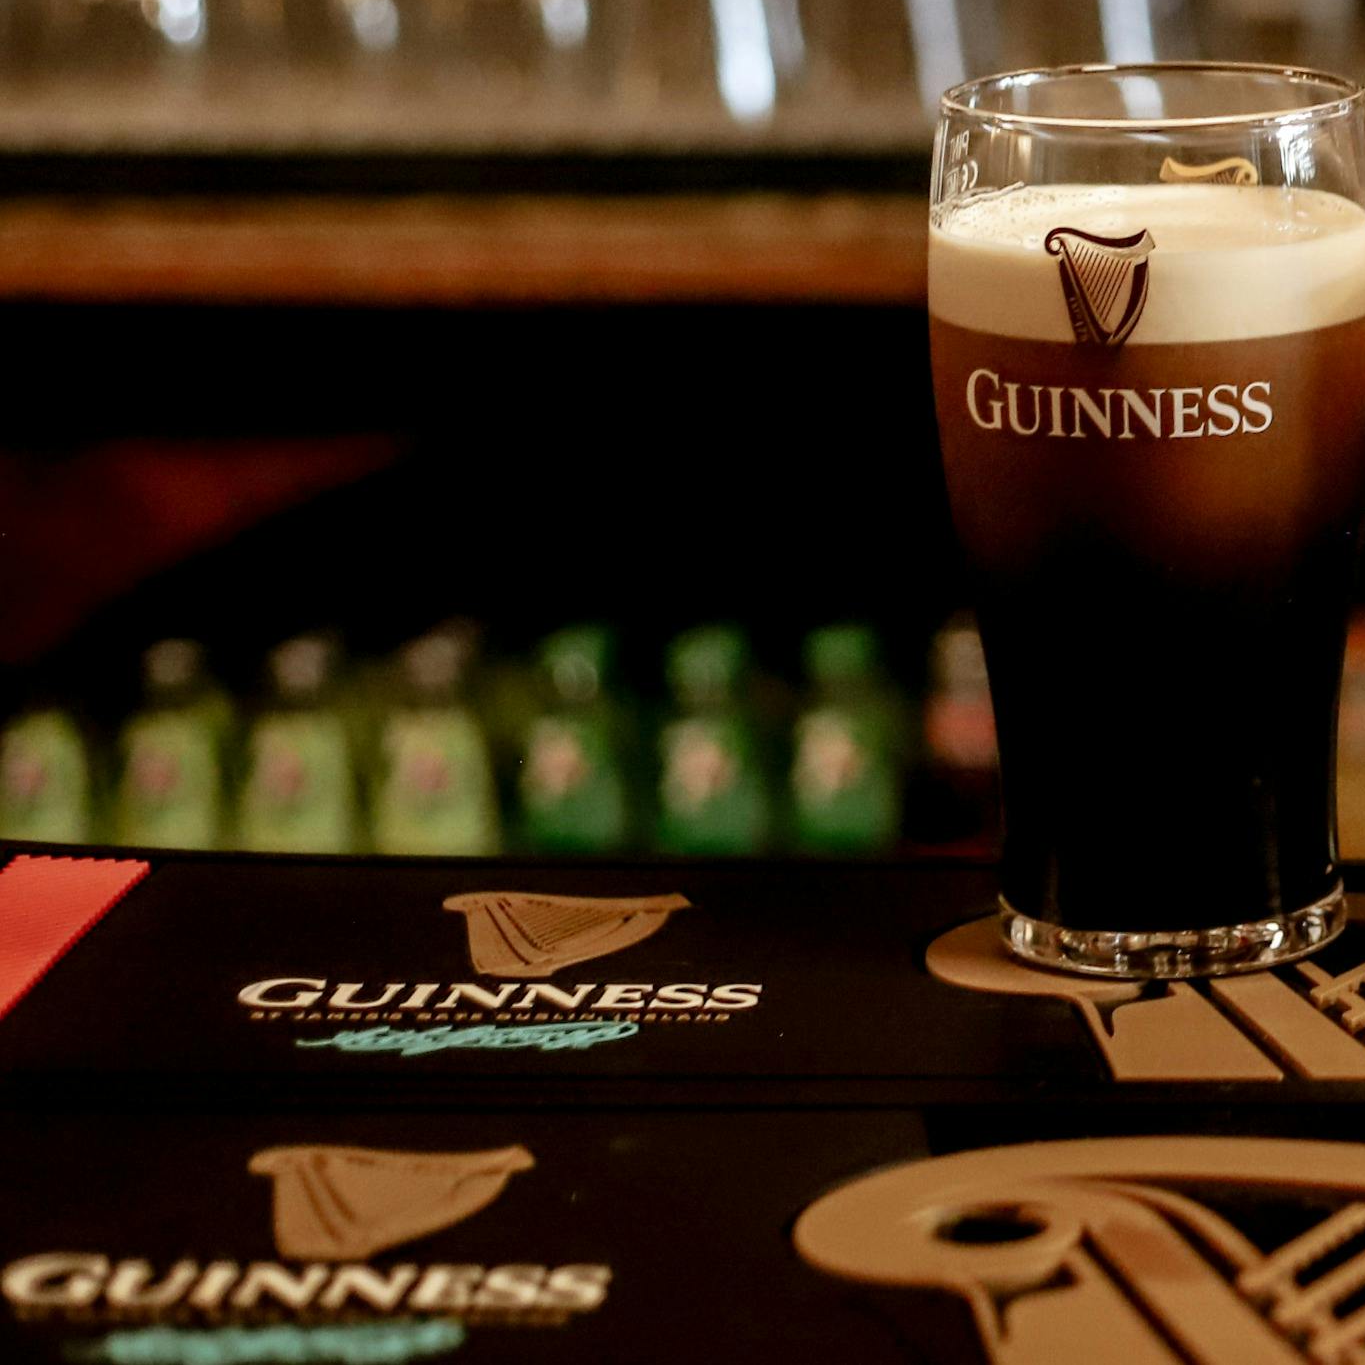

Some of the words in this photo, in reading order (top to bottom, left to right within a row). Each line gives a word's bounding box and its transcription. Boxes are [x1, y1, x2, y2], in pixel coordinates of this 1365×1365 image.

[967, 369, 1274, 440] GUINNESS
[238, 977, 763, 1010] GUINNESS
[2, 1251, 612, 1309] GUINNESS
